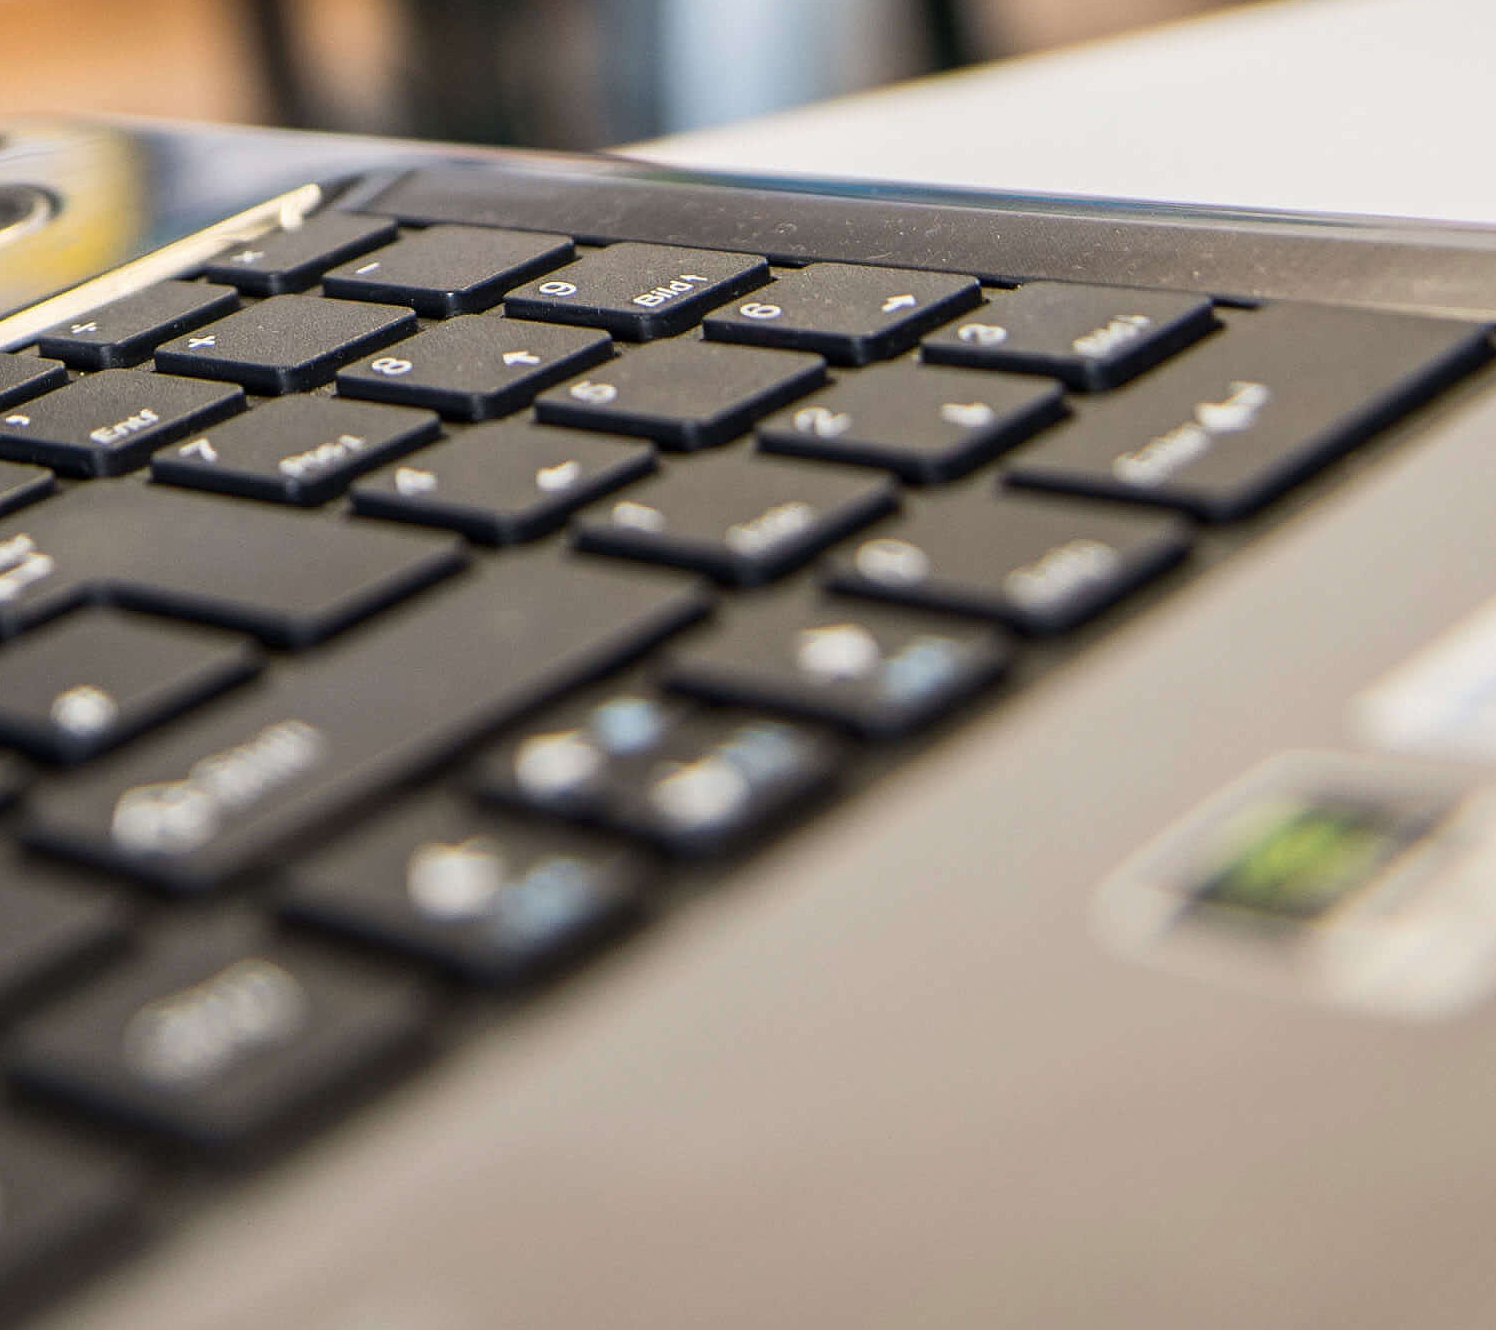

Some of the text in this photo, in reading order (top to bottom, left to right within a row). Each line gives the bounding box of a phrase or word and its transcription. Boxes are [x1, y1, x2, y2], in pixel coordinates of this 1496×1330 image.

[537, 280, 578, 297] 9
[633, 279, 693, 308] Bild
[739, 302, 783, 319] 6
[371, 357, 413, 377] 8
